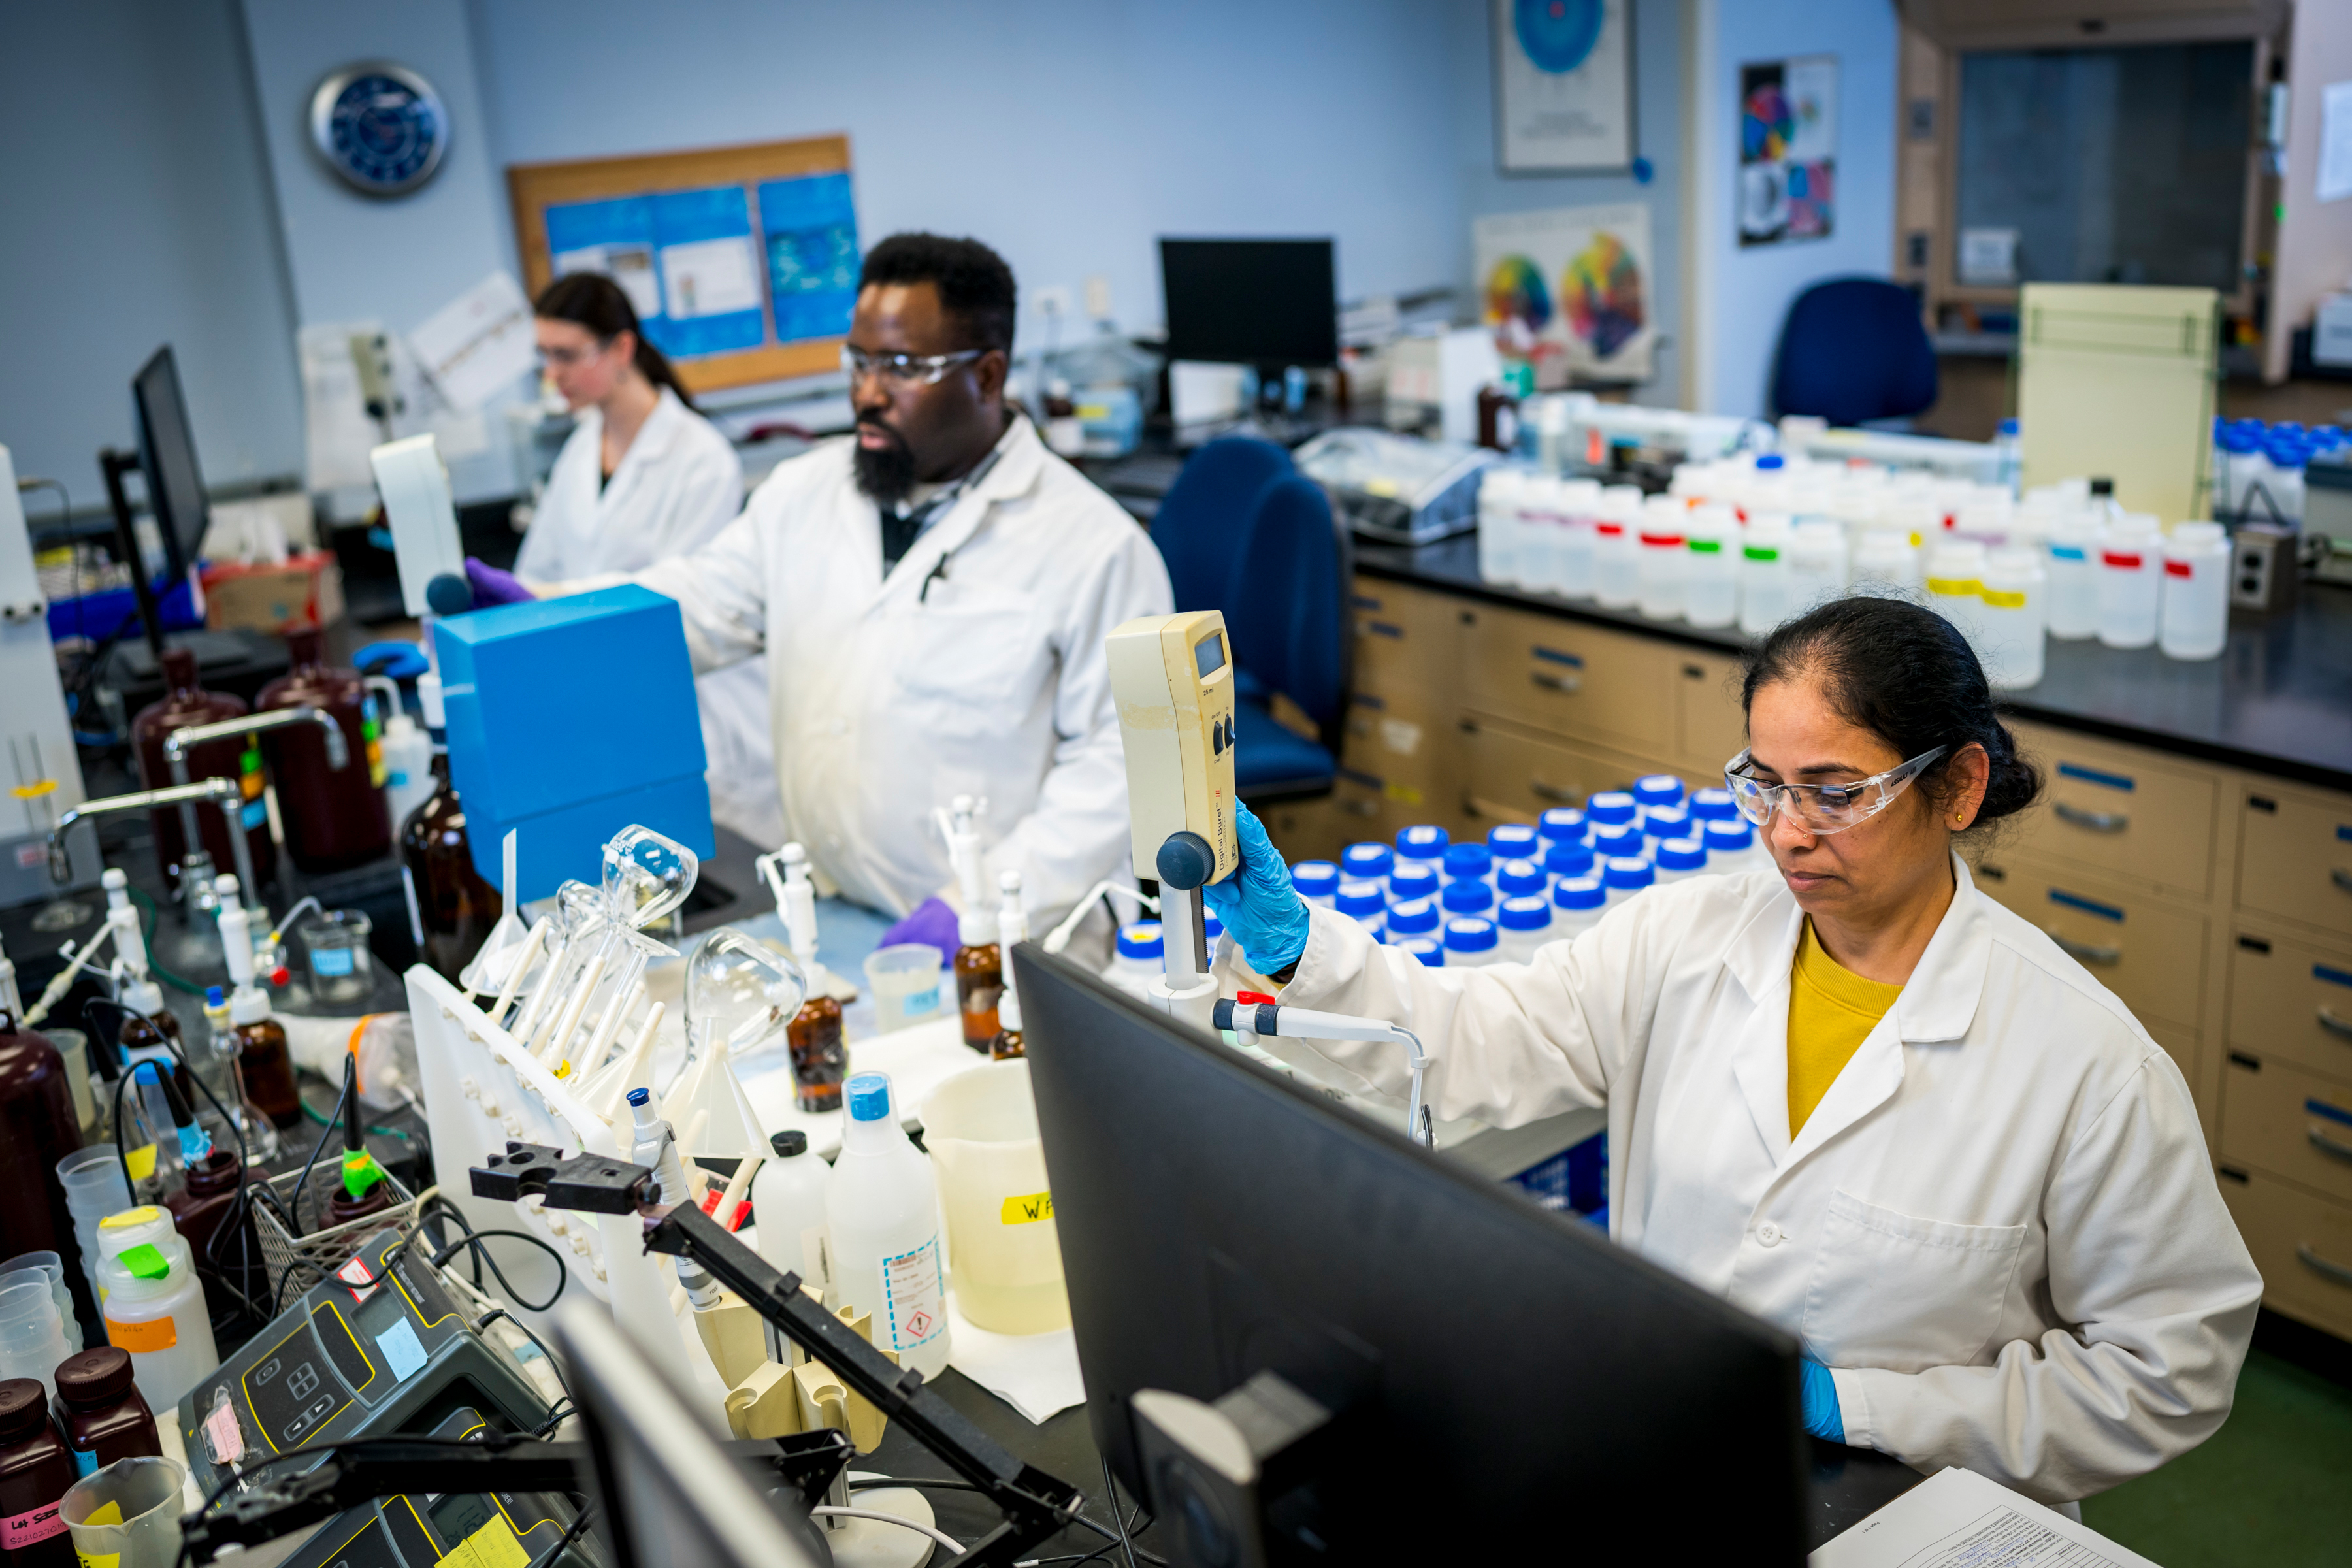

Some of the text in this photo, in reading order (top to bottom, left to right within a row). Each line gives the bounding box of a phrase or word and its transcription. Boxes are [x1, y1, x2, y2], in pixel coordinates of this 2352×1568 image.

[1890, 772, 1908, 788] ASSAULT
[12, 1518, 29, 1531] Lot
[1869, 1520, 1880, 1528] Page
[1992, 1516, 2008, 1526] reviewed
[1999, 1518, 2013, 1527] entered
[1975, 1526, 1993, 1536] Approved
[2014, 1546, 2029, 1556] between
